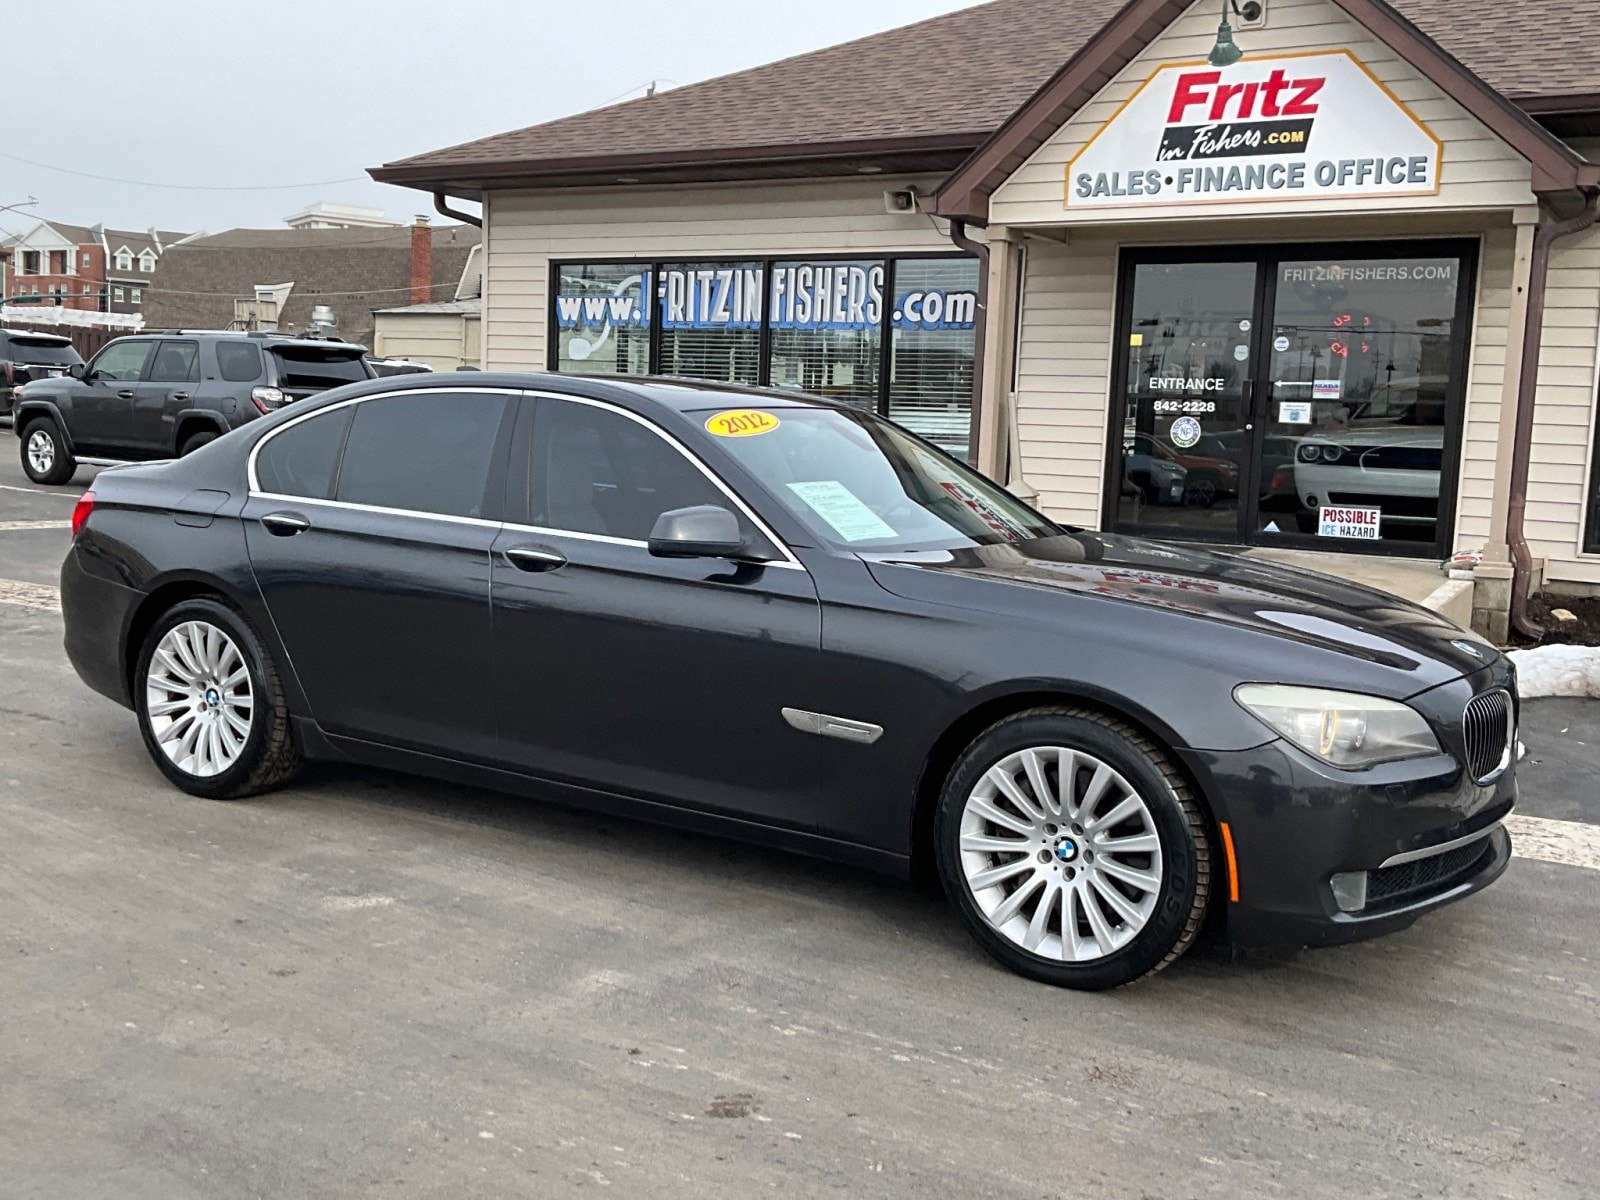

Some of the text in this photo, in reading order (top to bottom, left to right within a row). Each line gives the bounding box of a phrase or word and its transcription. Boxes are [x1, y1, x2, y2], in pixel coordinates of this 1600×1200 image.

[1166, 69, 1326, 123] Fritz
[1158, 140, 1185, 161] in
[1177, 161, 1306, 193] FINANCE
[1314, 156, 1429, 188] OFFICE
[1284, 265, 1451, 282] FRITZINFISHERS.COM
[1149, 377, 1225, 391] ENTRANCE
[1153, 401, 1216, 413] 842-2228
[720, 411, 771, 435] 2012
[1322, 508, 1377, 526] POSSIBLE
[1321, 524, 1376, 539] ICE HAZARD
